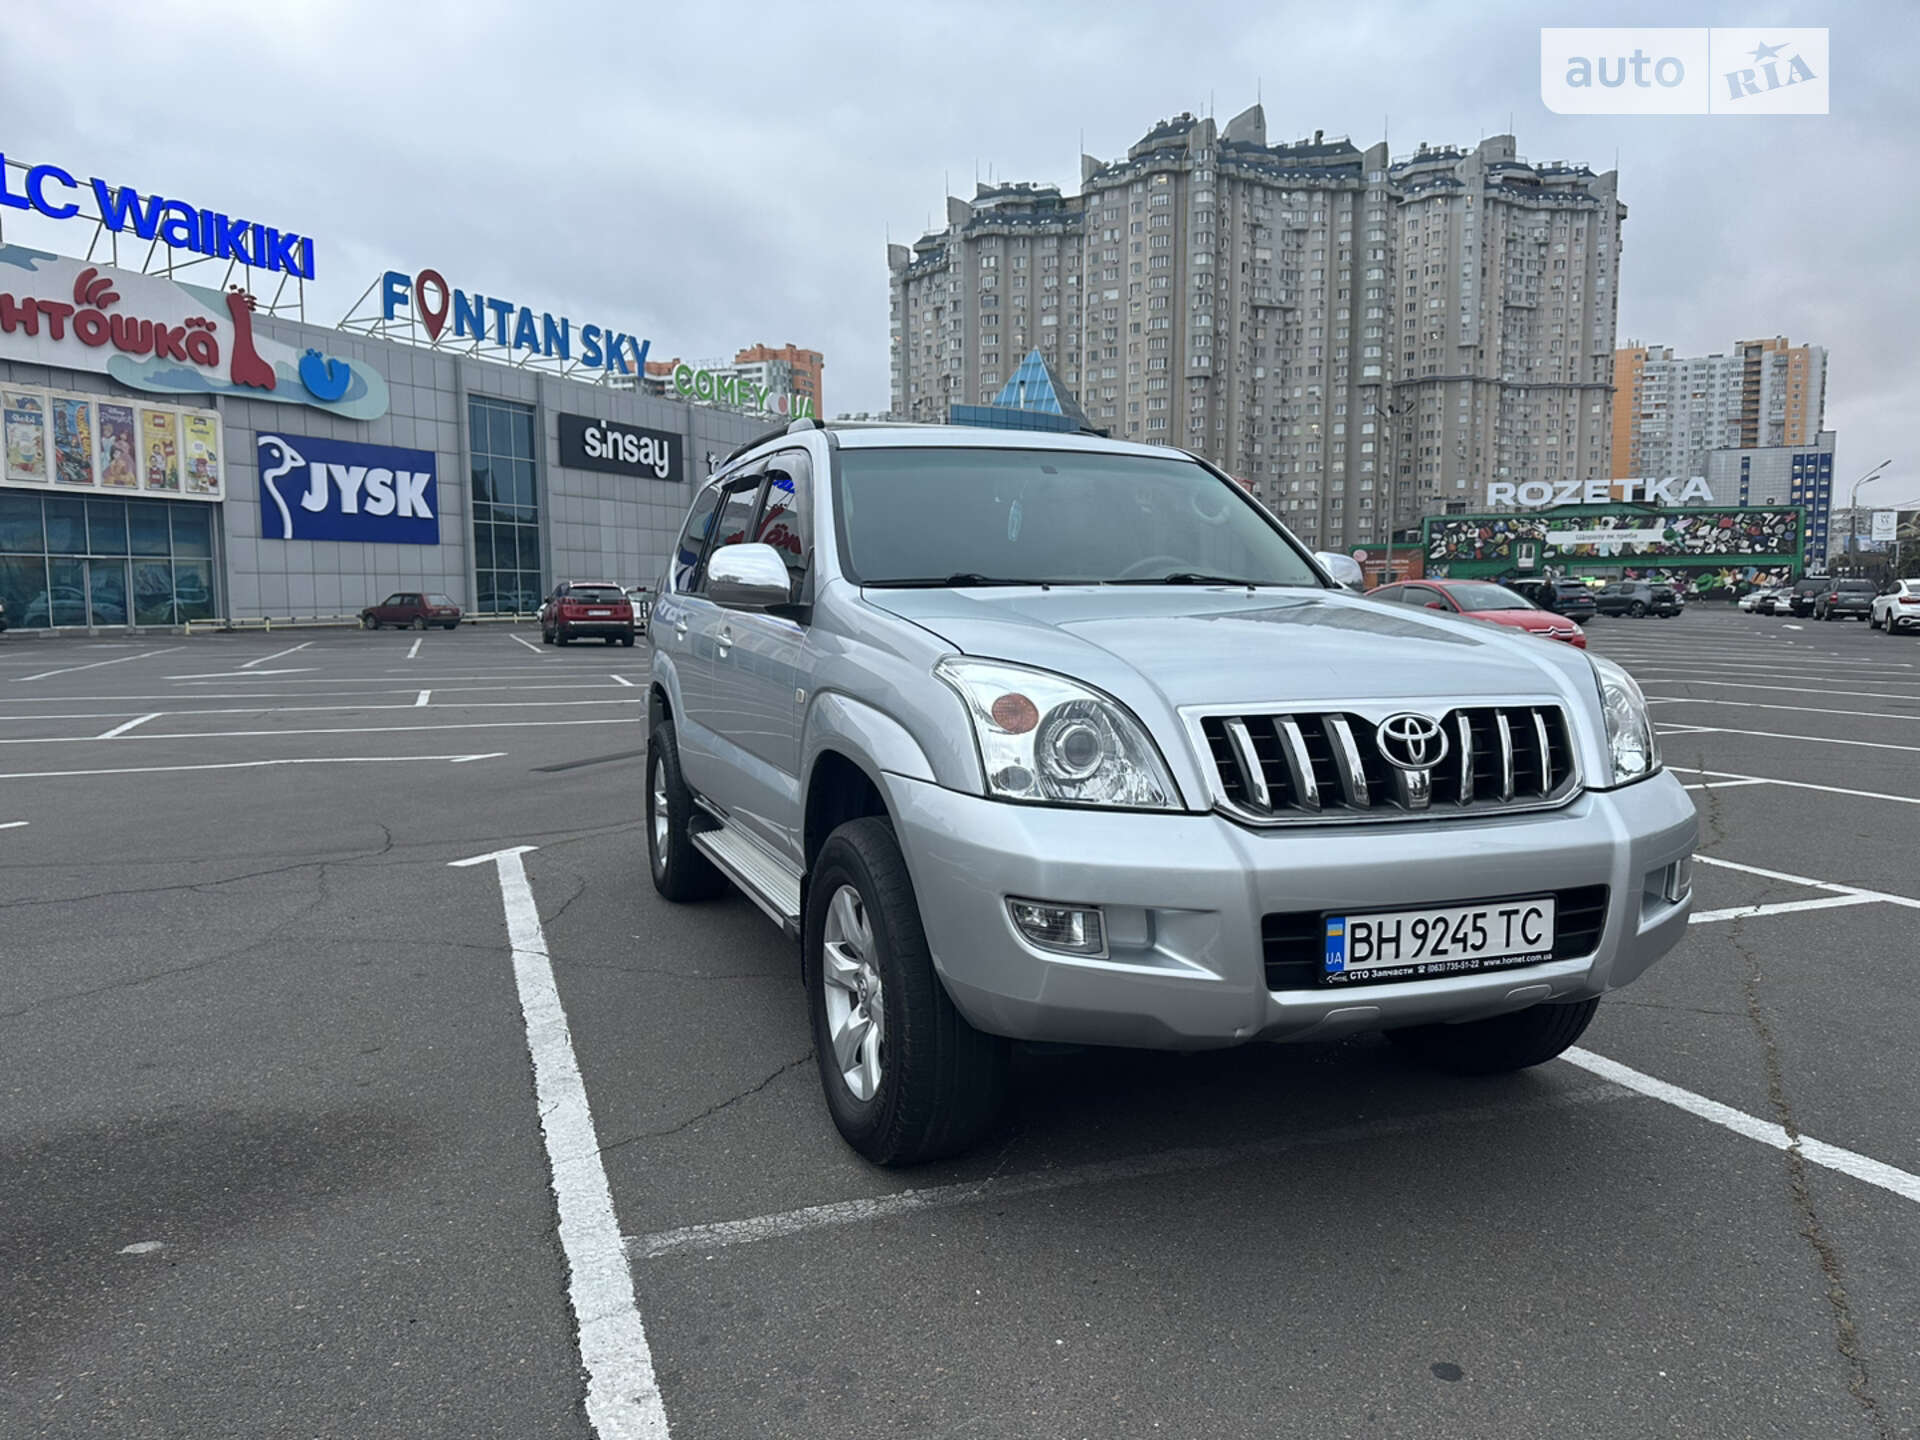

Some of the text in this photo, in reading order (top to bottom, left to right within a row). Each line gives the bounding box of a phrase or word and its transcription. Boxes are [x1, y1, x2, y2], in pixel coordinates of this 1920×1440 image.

[580, 323, 652, 379] SKY
[673, 364, 769, 412] COMFY
[584, 420, 669, 478] sinsay
[301, 462, 434, 519] JYSK
[1487, 476, 1714, 506] ROZETKA
[1326, 952, 1342, 965] UA
[1350, 908, 1543, 963] BH 9245 TC
[1350, 970, 1369, 980] СТО
[1371, 967, 1415, 979] Запчасти
